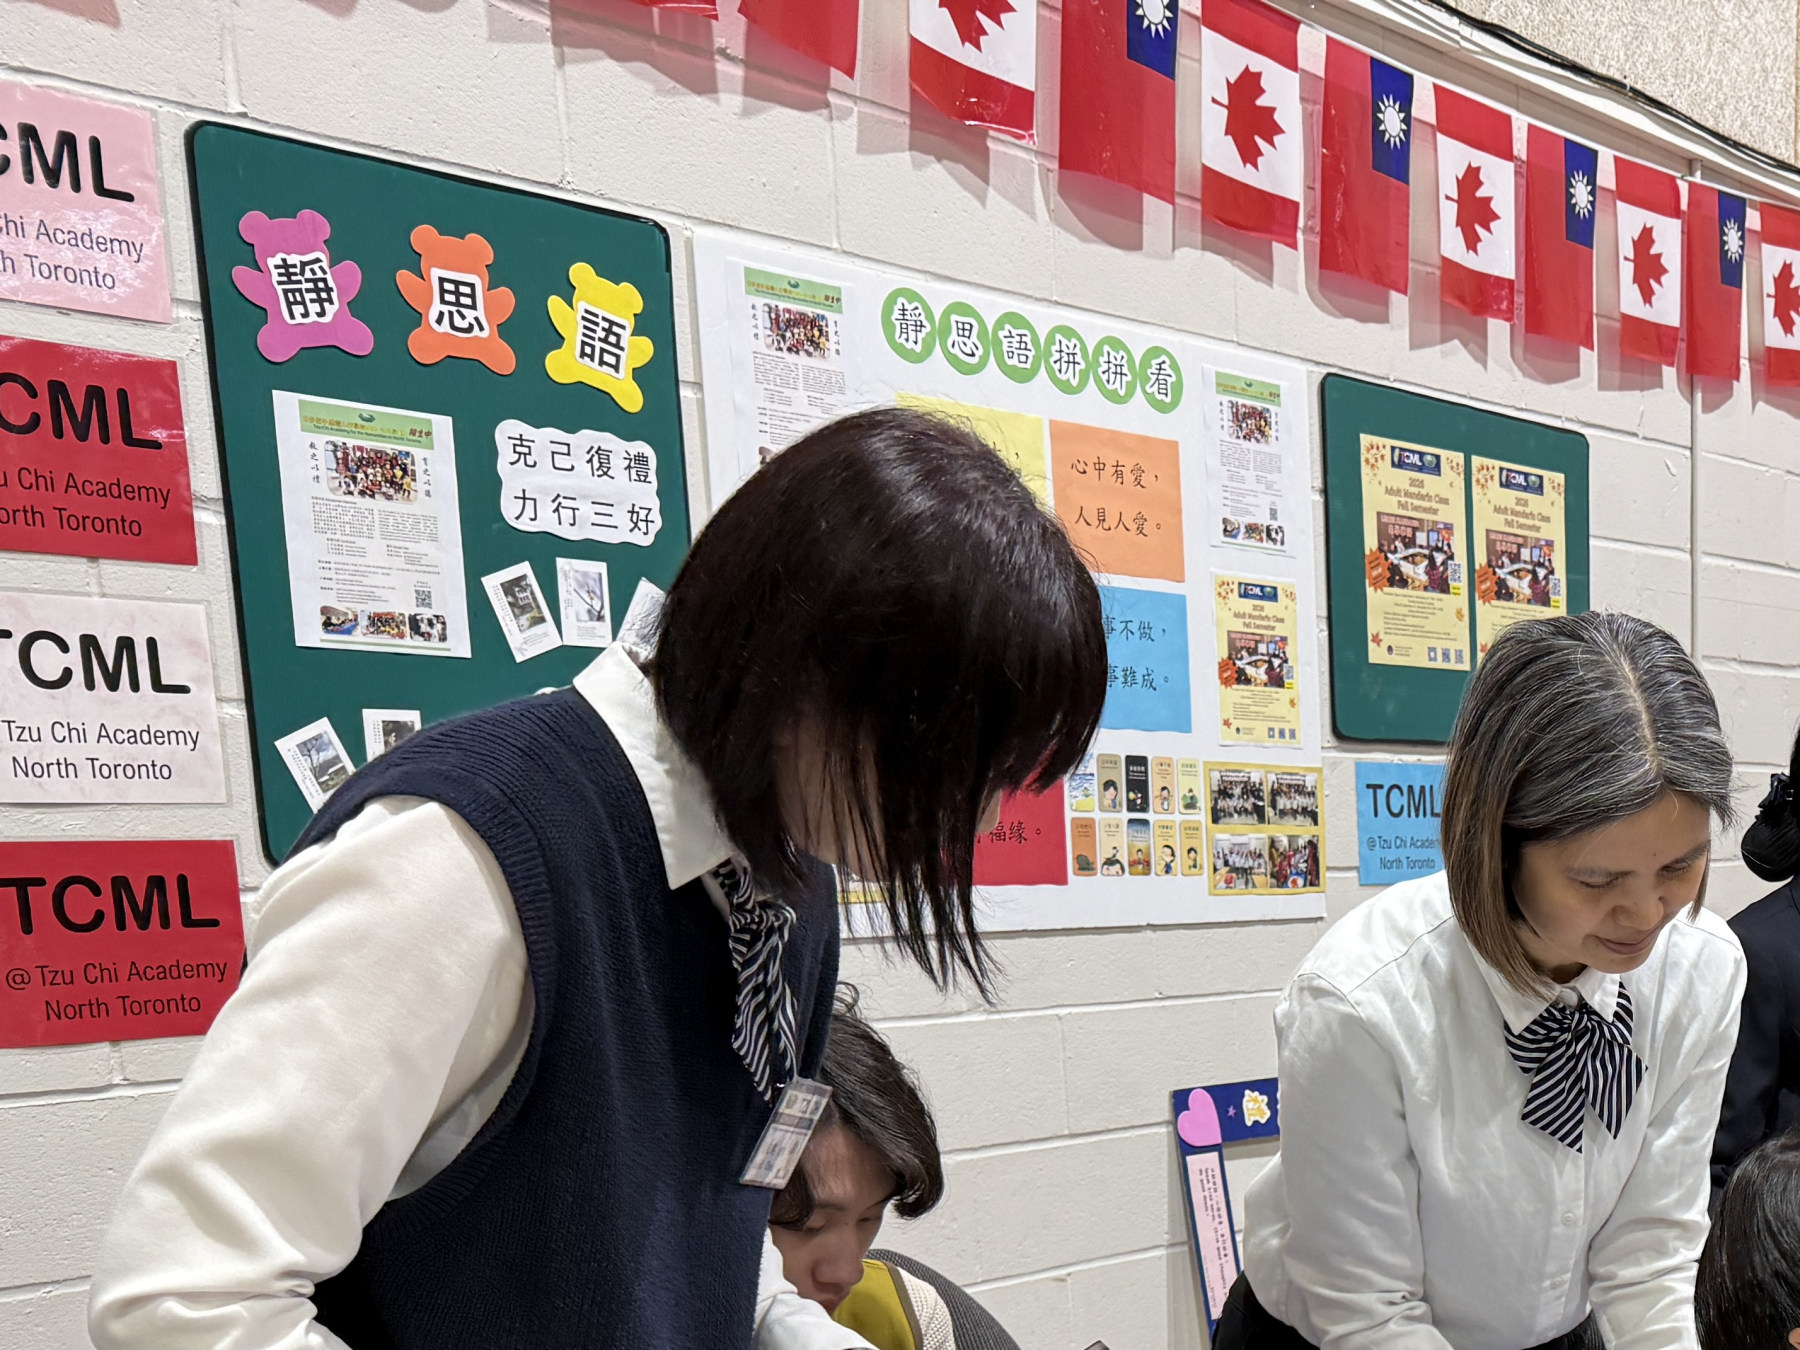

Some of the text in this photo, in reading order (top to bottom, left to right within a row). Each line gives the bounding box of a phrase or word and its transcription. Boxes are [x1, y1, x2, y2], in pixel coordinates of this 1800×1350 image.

[0, 122, 135, 203] ML
[35, 218, 144, 264] Academy
[23, 255, 117, 291] Toronto
[893, 303, 1178, 399] 靜思語拼拼看
[507, 432, 654, 486] 克己復禮
[1071, 456, 1160, 489] 心中有愛，
[17, 468, 172, 510] Chi Academy
[1385, 487, 1449, 505] Adult Mandarin Class
[57, 505, 144, 539] Toronto
[513, 488, 656, 537] 力行三好
[1075, 505, 1163, 538] 人見人愛。
[1398, 501, 1439, 515] Fall Semester
[1, 720, 200, 752] Tzu Chi Academy
[12, 757, 173, 782] North Toronto
[1366, 783, 1441, 818] TCML
[1377, 836, 1407, 849] Tzu Chi
[1380, 856, 1435, 870] North Toronto
[0, 873, 221, 937] TCML
[5, 957, 228, 992] @ Tzu Chi Academy
[44, 992, 202, 1022] North Toronto
